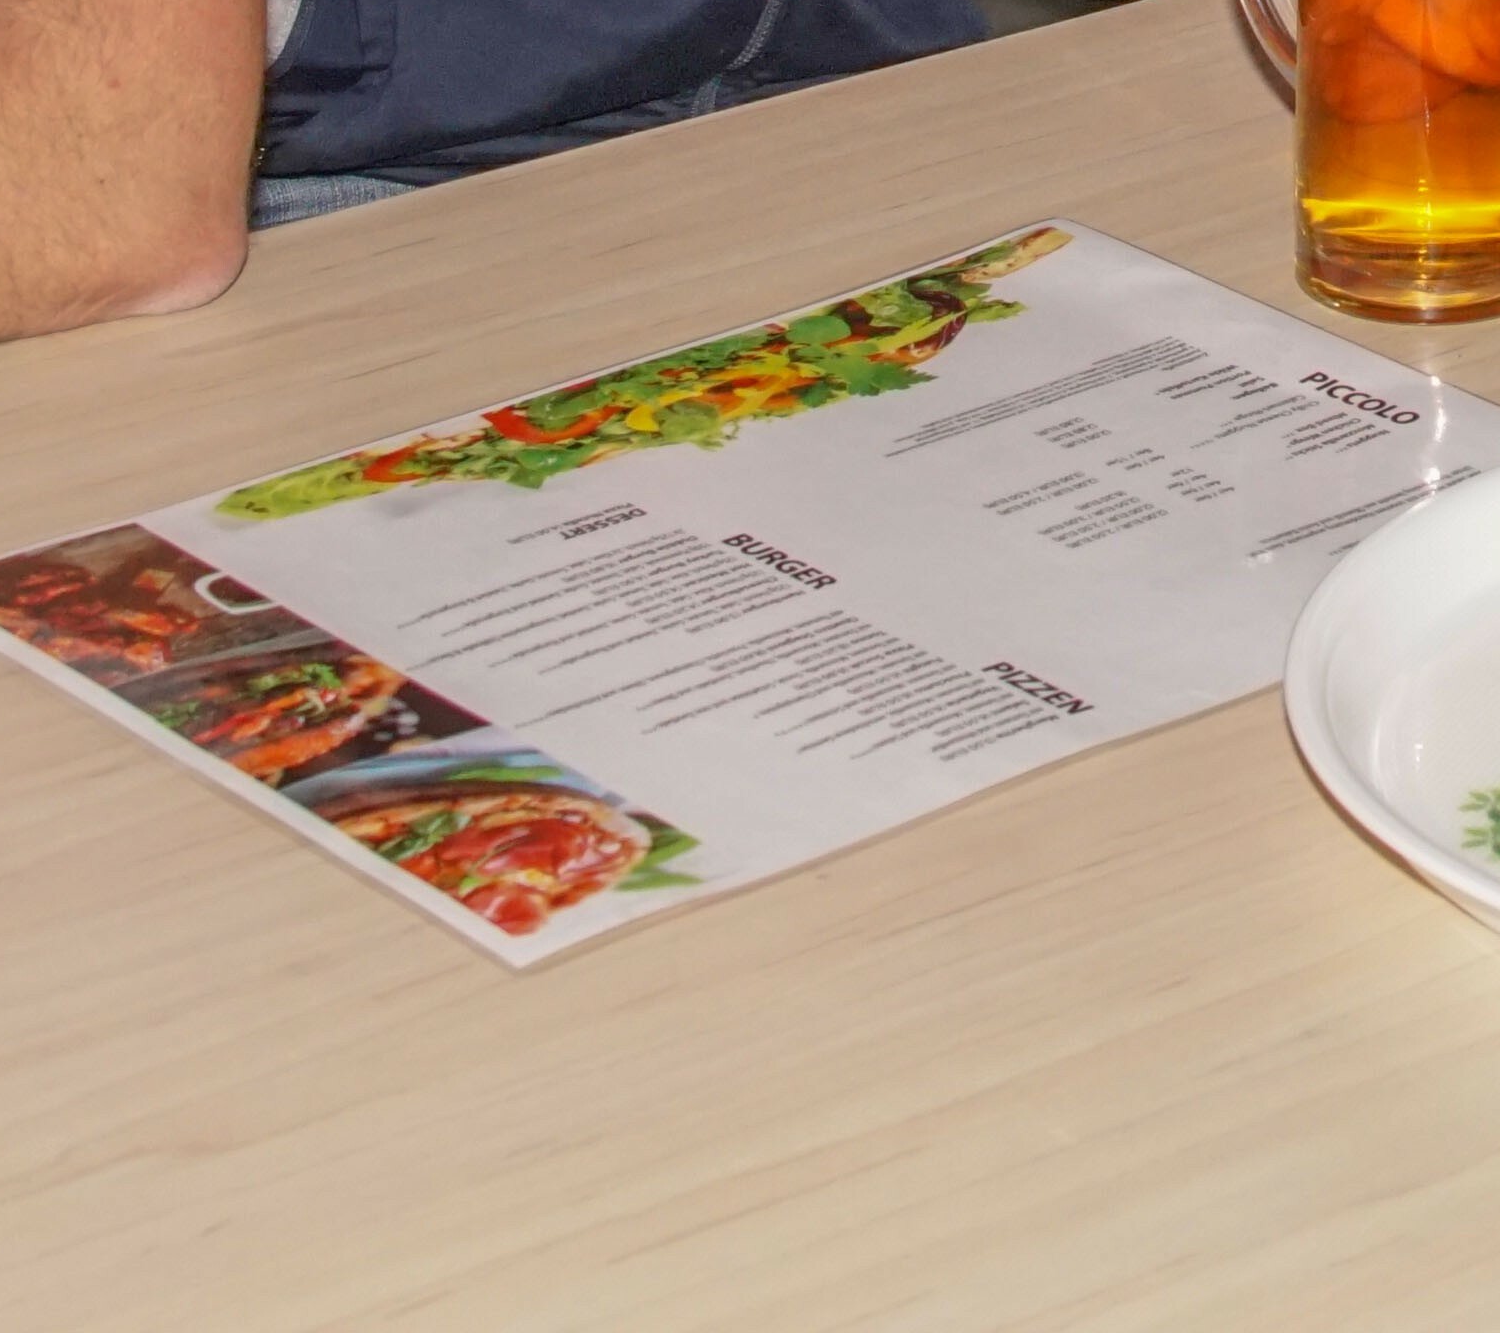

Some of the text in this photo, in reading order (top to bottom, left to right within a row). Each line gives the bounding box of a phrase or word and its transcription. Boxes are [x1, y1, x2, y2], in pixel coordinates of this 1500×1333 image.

[1298, 371, 1420, 426] PICCOLO
[562, 507, 647, 540] DESSERT
[721, 532, 837, 591] BURGER
[983, 661, 1094, 717] PIZZEN
